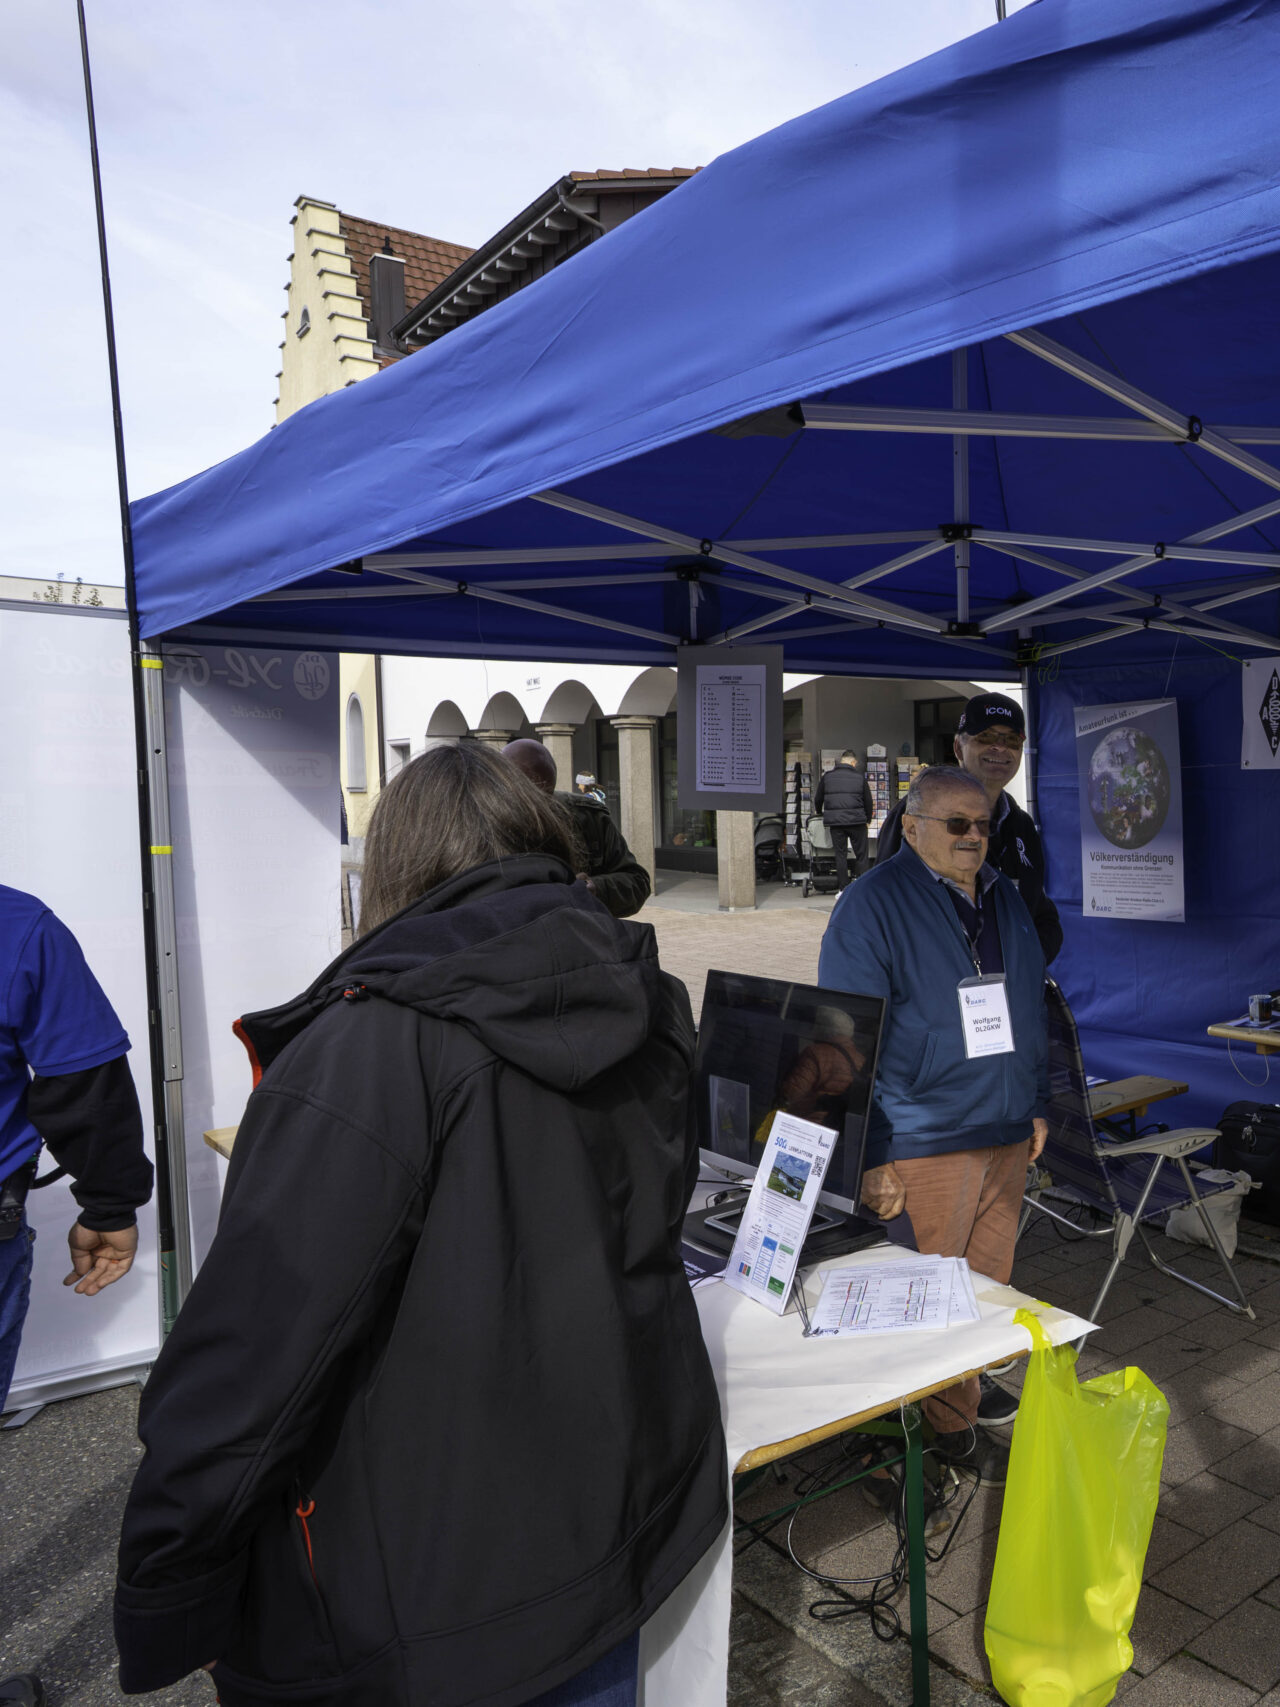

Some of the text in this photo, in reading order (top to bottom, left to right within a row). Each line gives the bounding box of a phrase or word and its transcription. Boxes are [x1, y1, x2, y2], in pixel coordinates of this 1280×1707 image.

[985, 706, 1012, 718] ICOM
[1078, 714, 1118, 734] Amateurfunk
[1118, 710, 1127, 720] ist
[1090, 851, 1174, 866] Völkerverständigung
[972, 1016, 1002, 1025] Wolfgang
[975, 1023, 1001, 1033] DL2GKW
